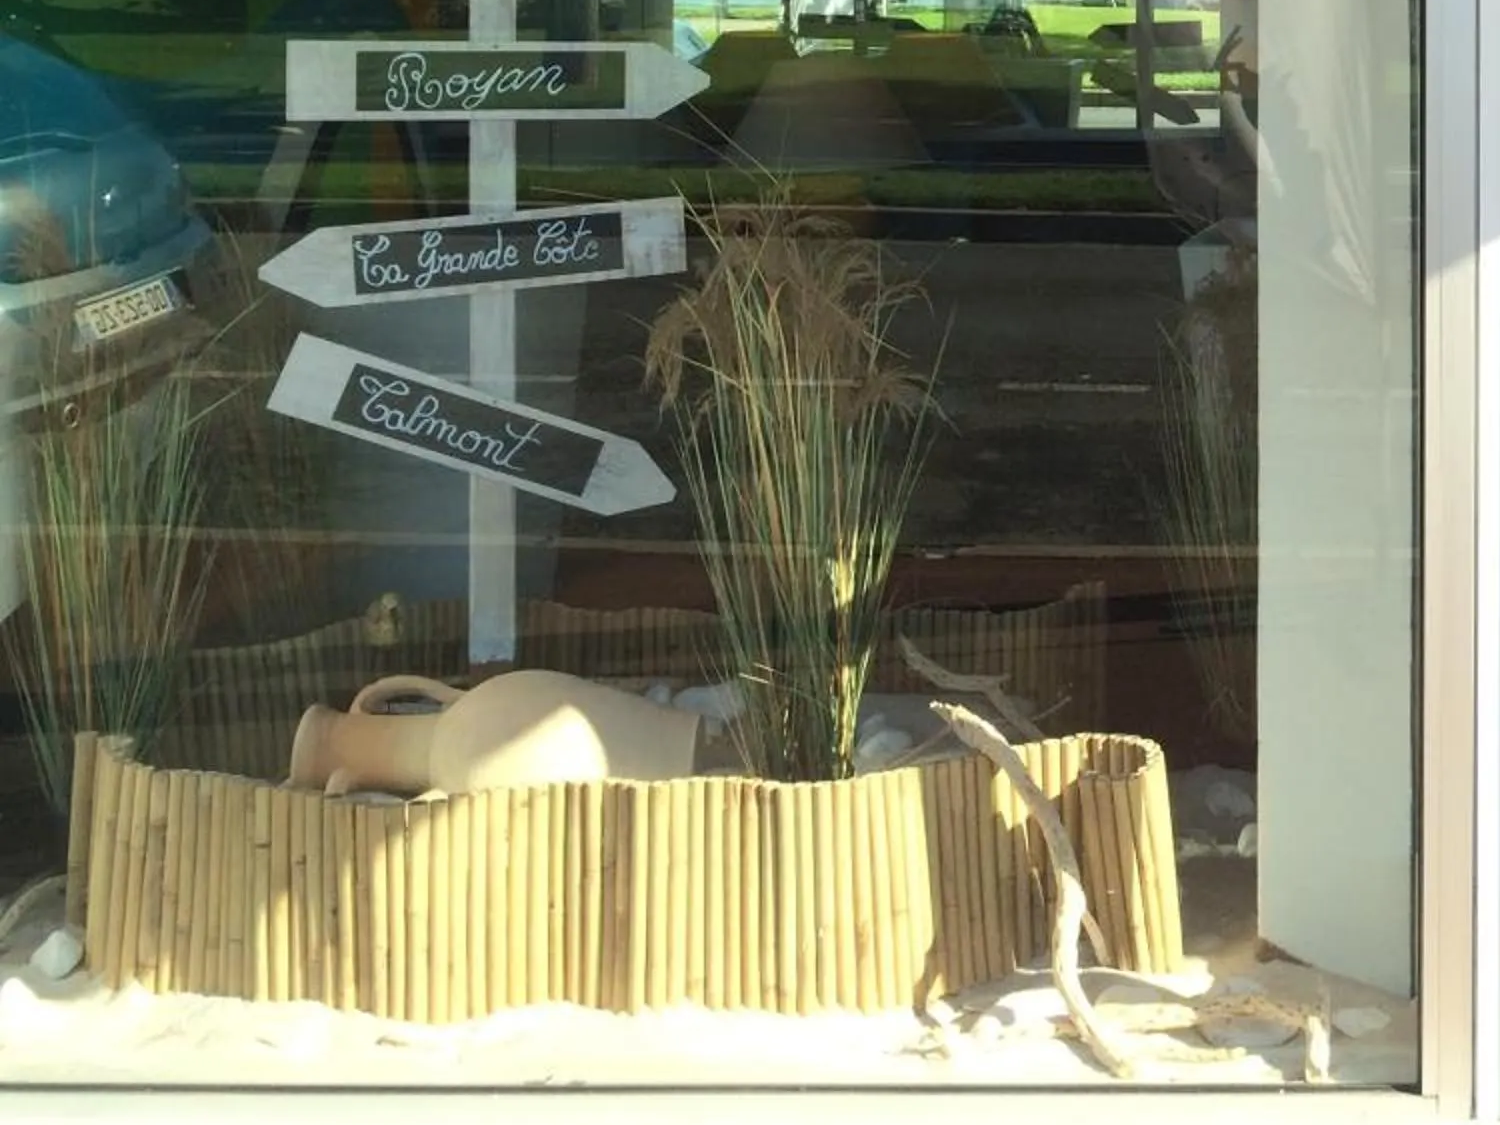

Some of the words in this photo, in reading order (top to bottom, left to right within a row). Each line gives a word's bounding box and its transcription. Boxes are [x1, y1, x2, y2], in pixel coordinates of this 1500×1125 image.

[385, 52, 567, 112] Royan
[354, 234, 409, 287] La
[415, 228, 520, 287] Grande
[359, 374, 542, 472] Talmont
